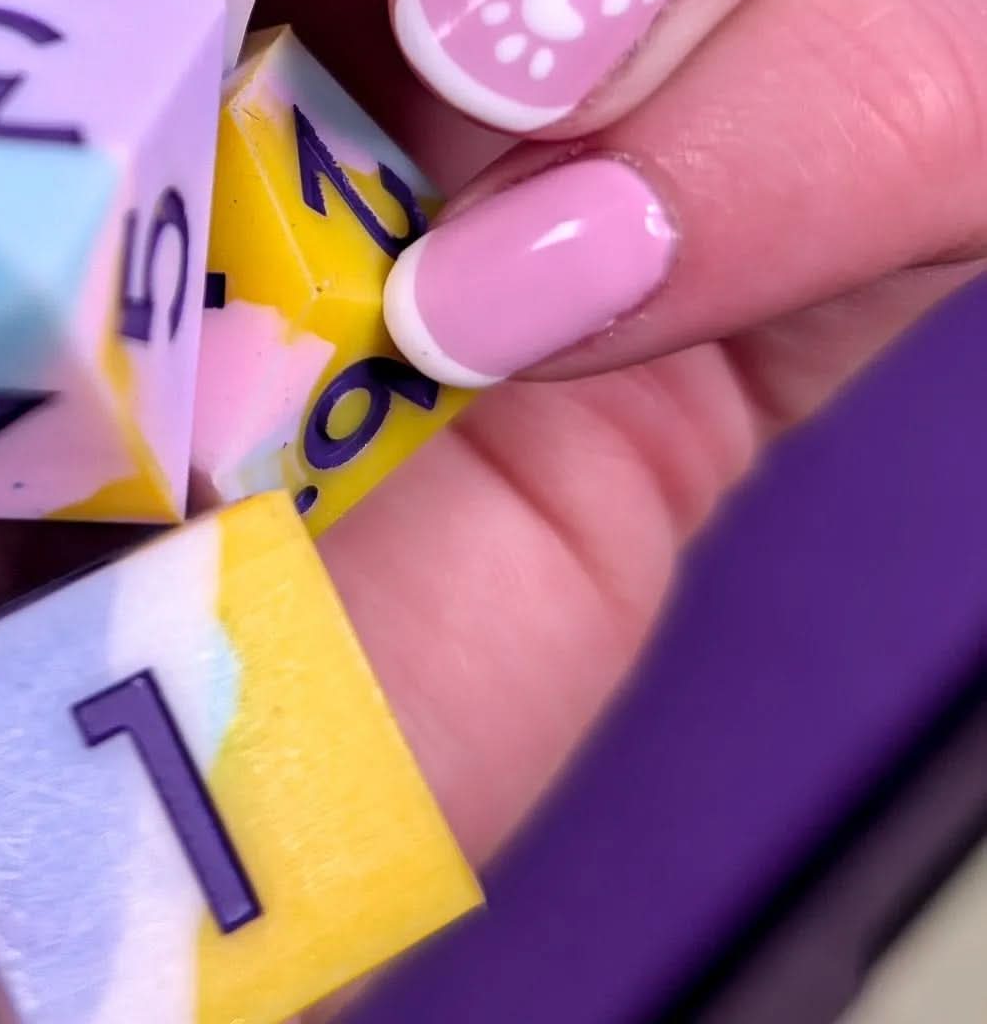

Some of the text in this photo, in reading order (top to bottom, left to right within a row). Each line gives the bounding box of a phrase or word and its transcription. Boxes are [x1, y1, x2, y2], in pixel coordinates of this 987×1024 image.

[292, 103, 429, 261] 2
[118, 185, 190, 344] 5
[71, 667, 264, 936] 1
